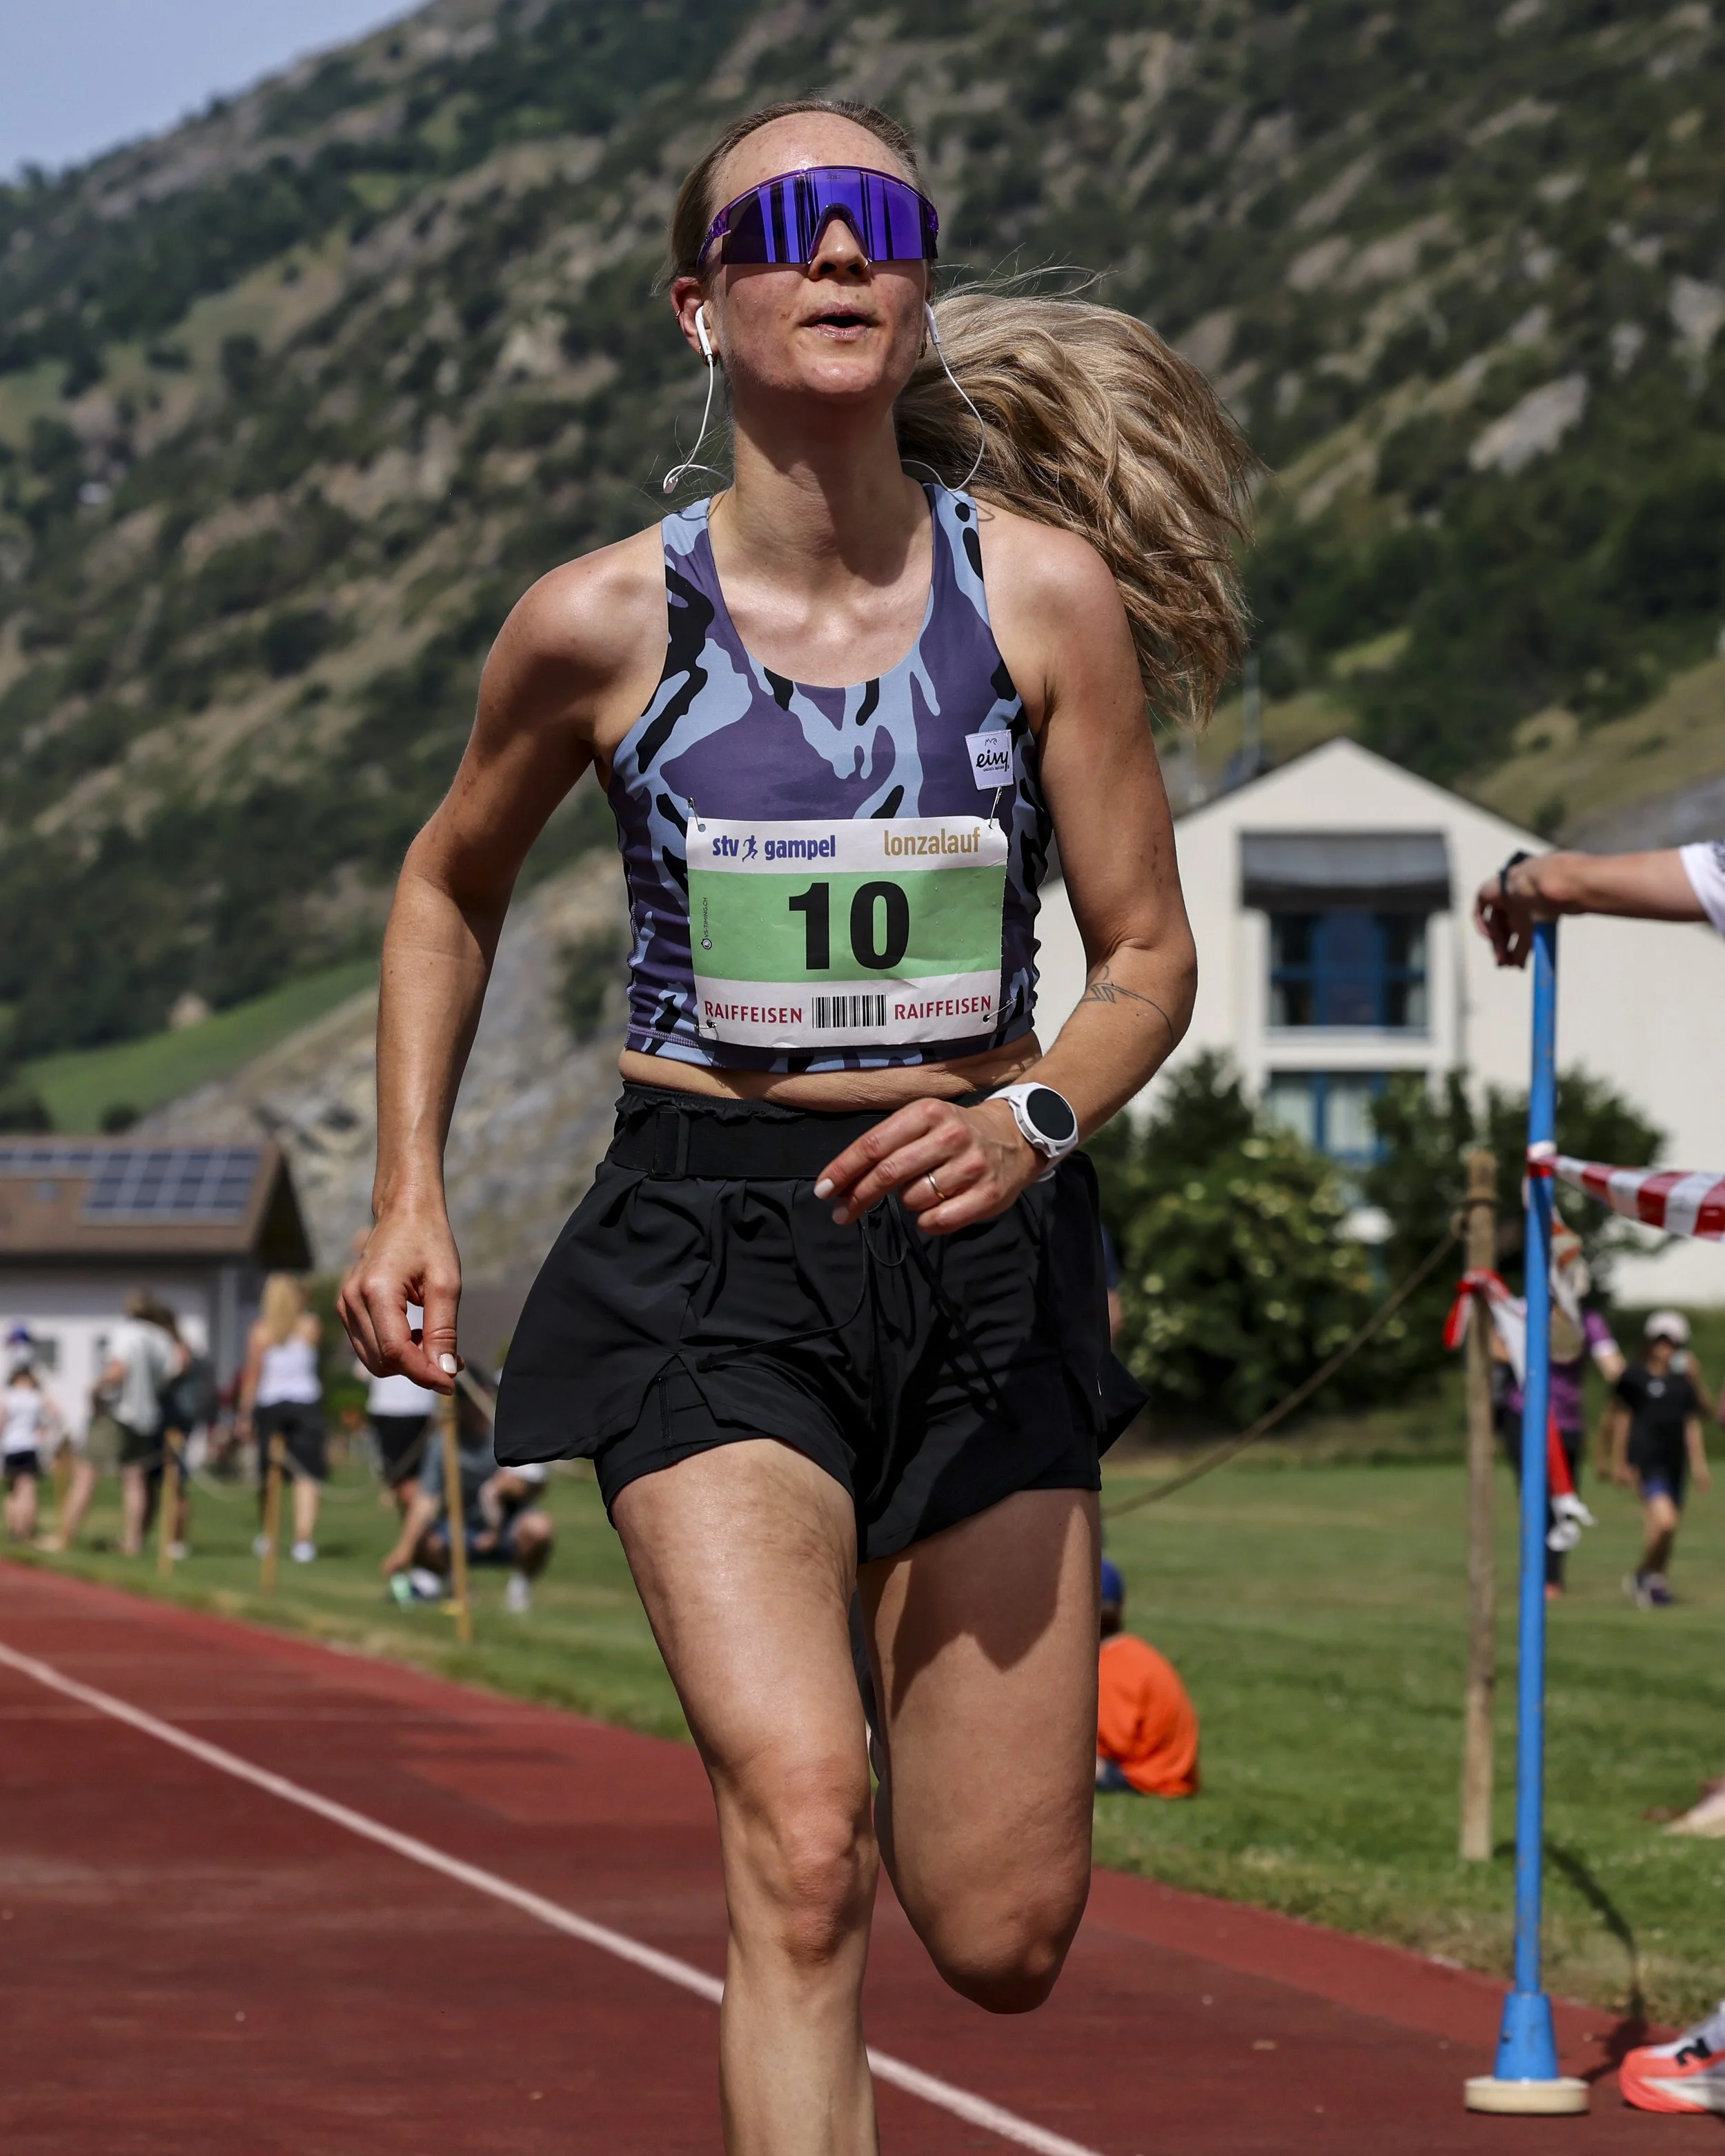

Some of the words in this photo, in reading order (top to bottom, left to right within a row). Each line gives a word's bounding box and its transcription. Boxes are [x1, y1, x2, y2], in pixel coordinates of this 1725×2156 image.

[976, 749, 1009, 772] eivy
[712, 835, 740, 857] stv
[765, 835, 836, 861] gampel
[884, 827, 981, 856] lonzalauf
[789, 881, 910, 971] 10
[704, 1000, 802, 1024] RAIFFEISEN
[894, 995, 992, 1020] RAIFFEISEN
